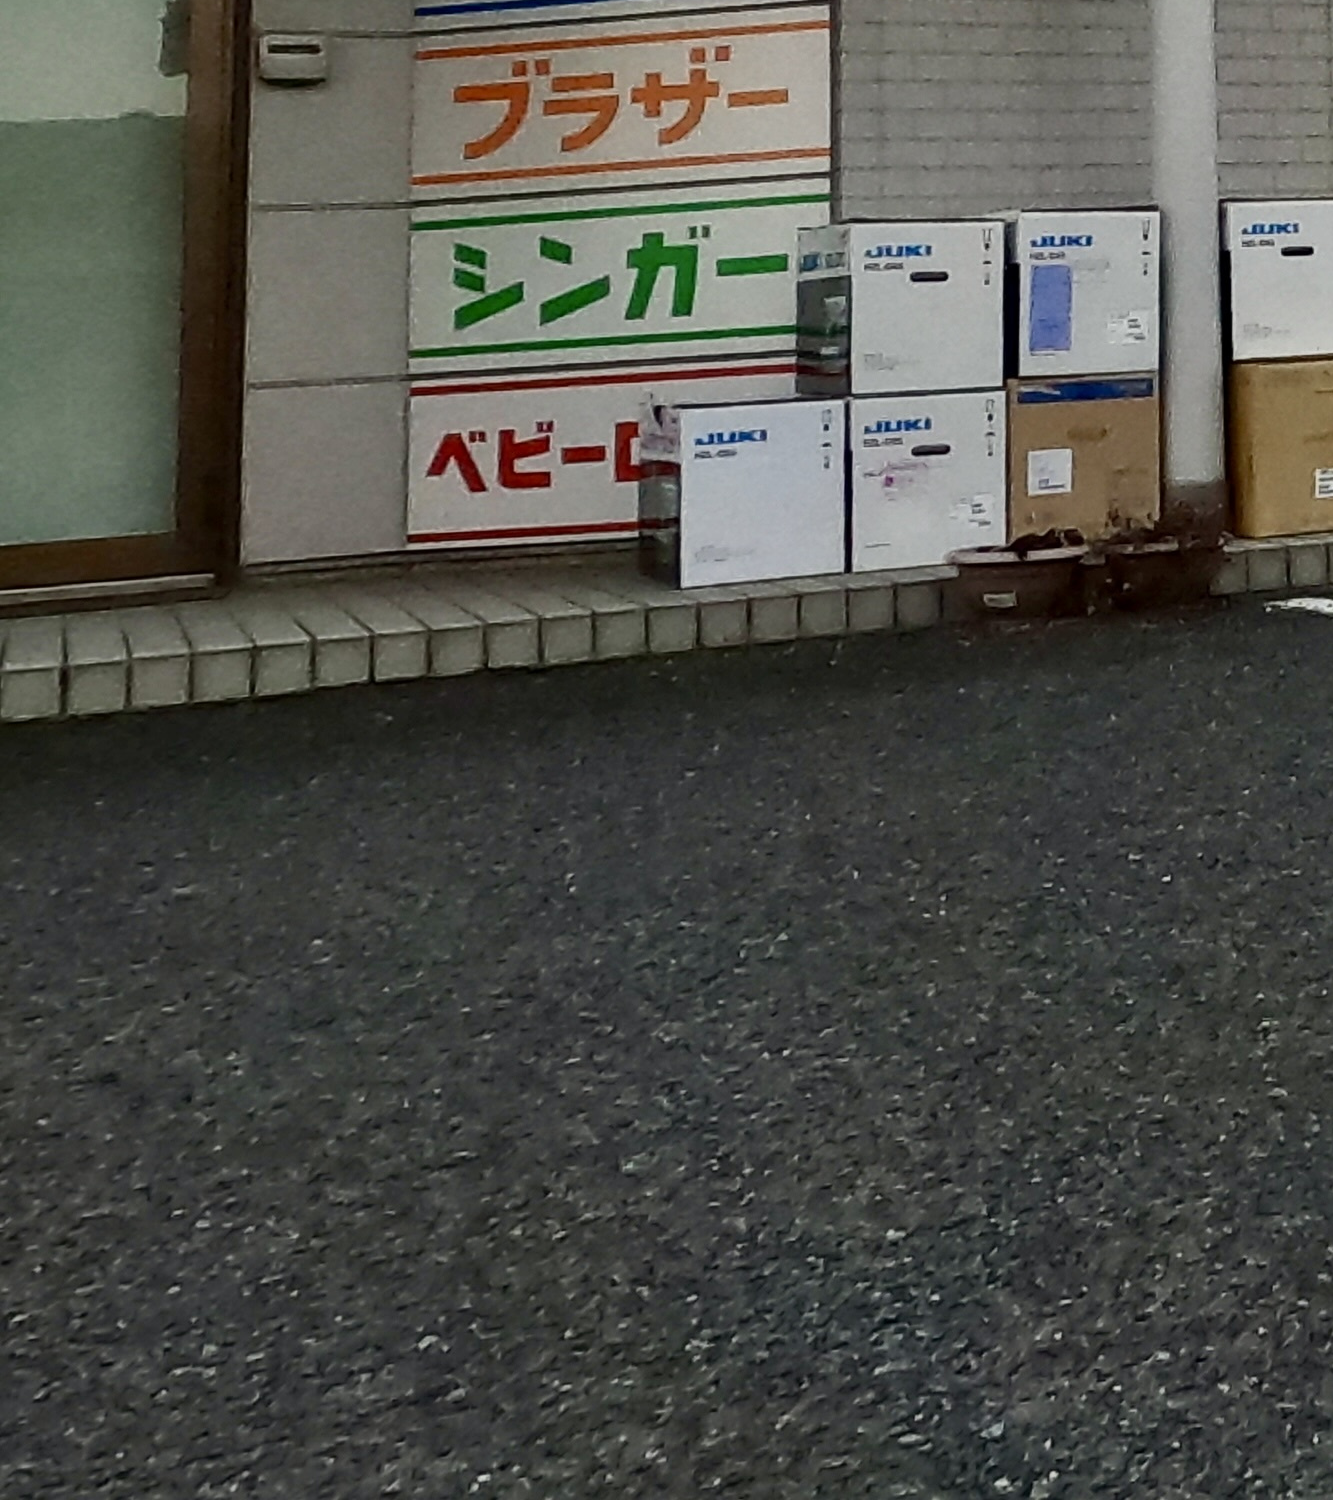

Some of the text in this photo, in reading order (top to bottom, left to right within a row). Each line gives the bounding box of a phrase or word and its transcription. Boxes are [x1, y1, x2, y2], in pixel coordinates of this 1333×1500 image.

[453, 45, 789, 160] ブラザー
[1029, 235, 1092, 248] JUKI
[864, 245, 932, 258] JUKI
[453, 225, 789, 331] シンガー
[863, 417, 932, 435] JUKI
[694, 429, 767, 446] JUKI
